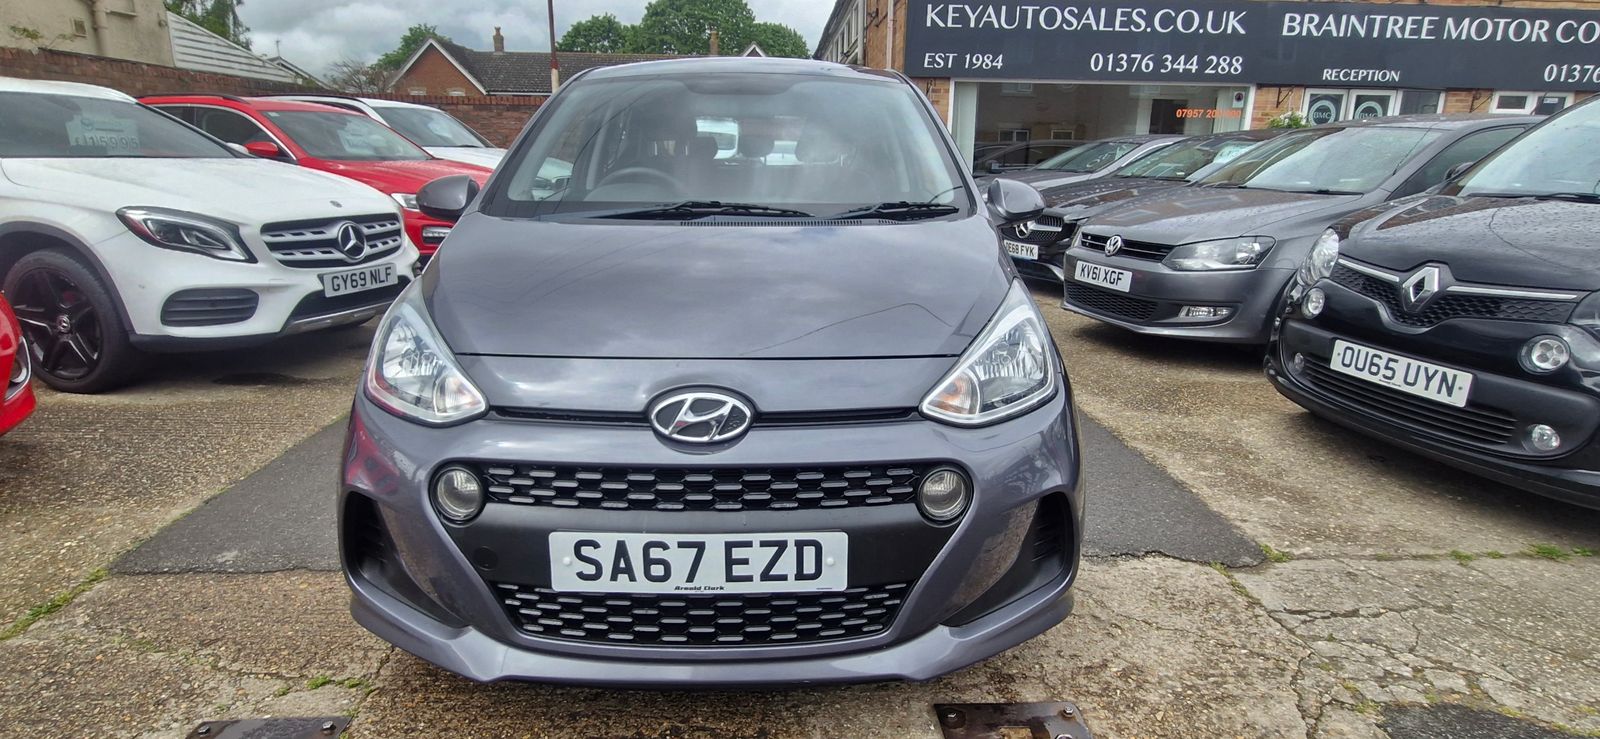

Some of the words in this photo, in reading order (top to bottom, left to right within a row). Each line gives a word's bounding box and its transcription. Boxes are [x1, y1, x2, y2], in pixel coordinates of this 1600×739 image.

[926, 4, 1246, 34] KEYAUTOSALES.CO.UK
[1281, 13, 1439, 39] BRAINTREE
[1443, 17, 1550, 42] MOTOR
[1555, 20, 1600, 43] CO
[923, 53, 957, 68] EST
[964, 53, 1003, 69] 1984
[1090, 53, 1153, 72] 01376
[1160, 54, 1198, 73] 344
[1204, 55, 1243, 74] 288
[1322, 68, 1401, 82] RECEPTION
[1176, 109, 1204, 119] 07957
[1020, 245, 1035, 257] FYK
[331, 271, 367, 292] GY69
[370, 267, 392, 286] NLF
[1079, 263, 1101, 282] KV61
[1102, 269, 1125, 286] XGF
[1341, 346, 1399, 381] OU65
[1403, 362, 1458, 398] UYN
[573, 539, 706, 583] SA67
[724, 539, 823, 583] EZD
